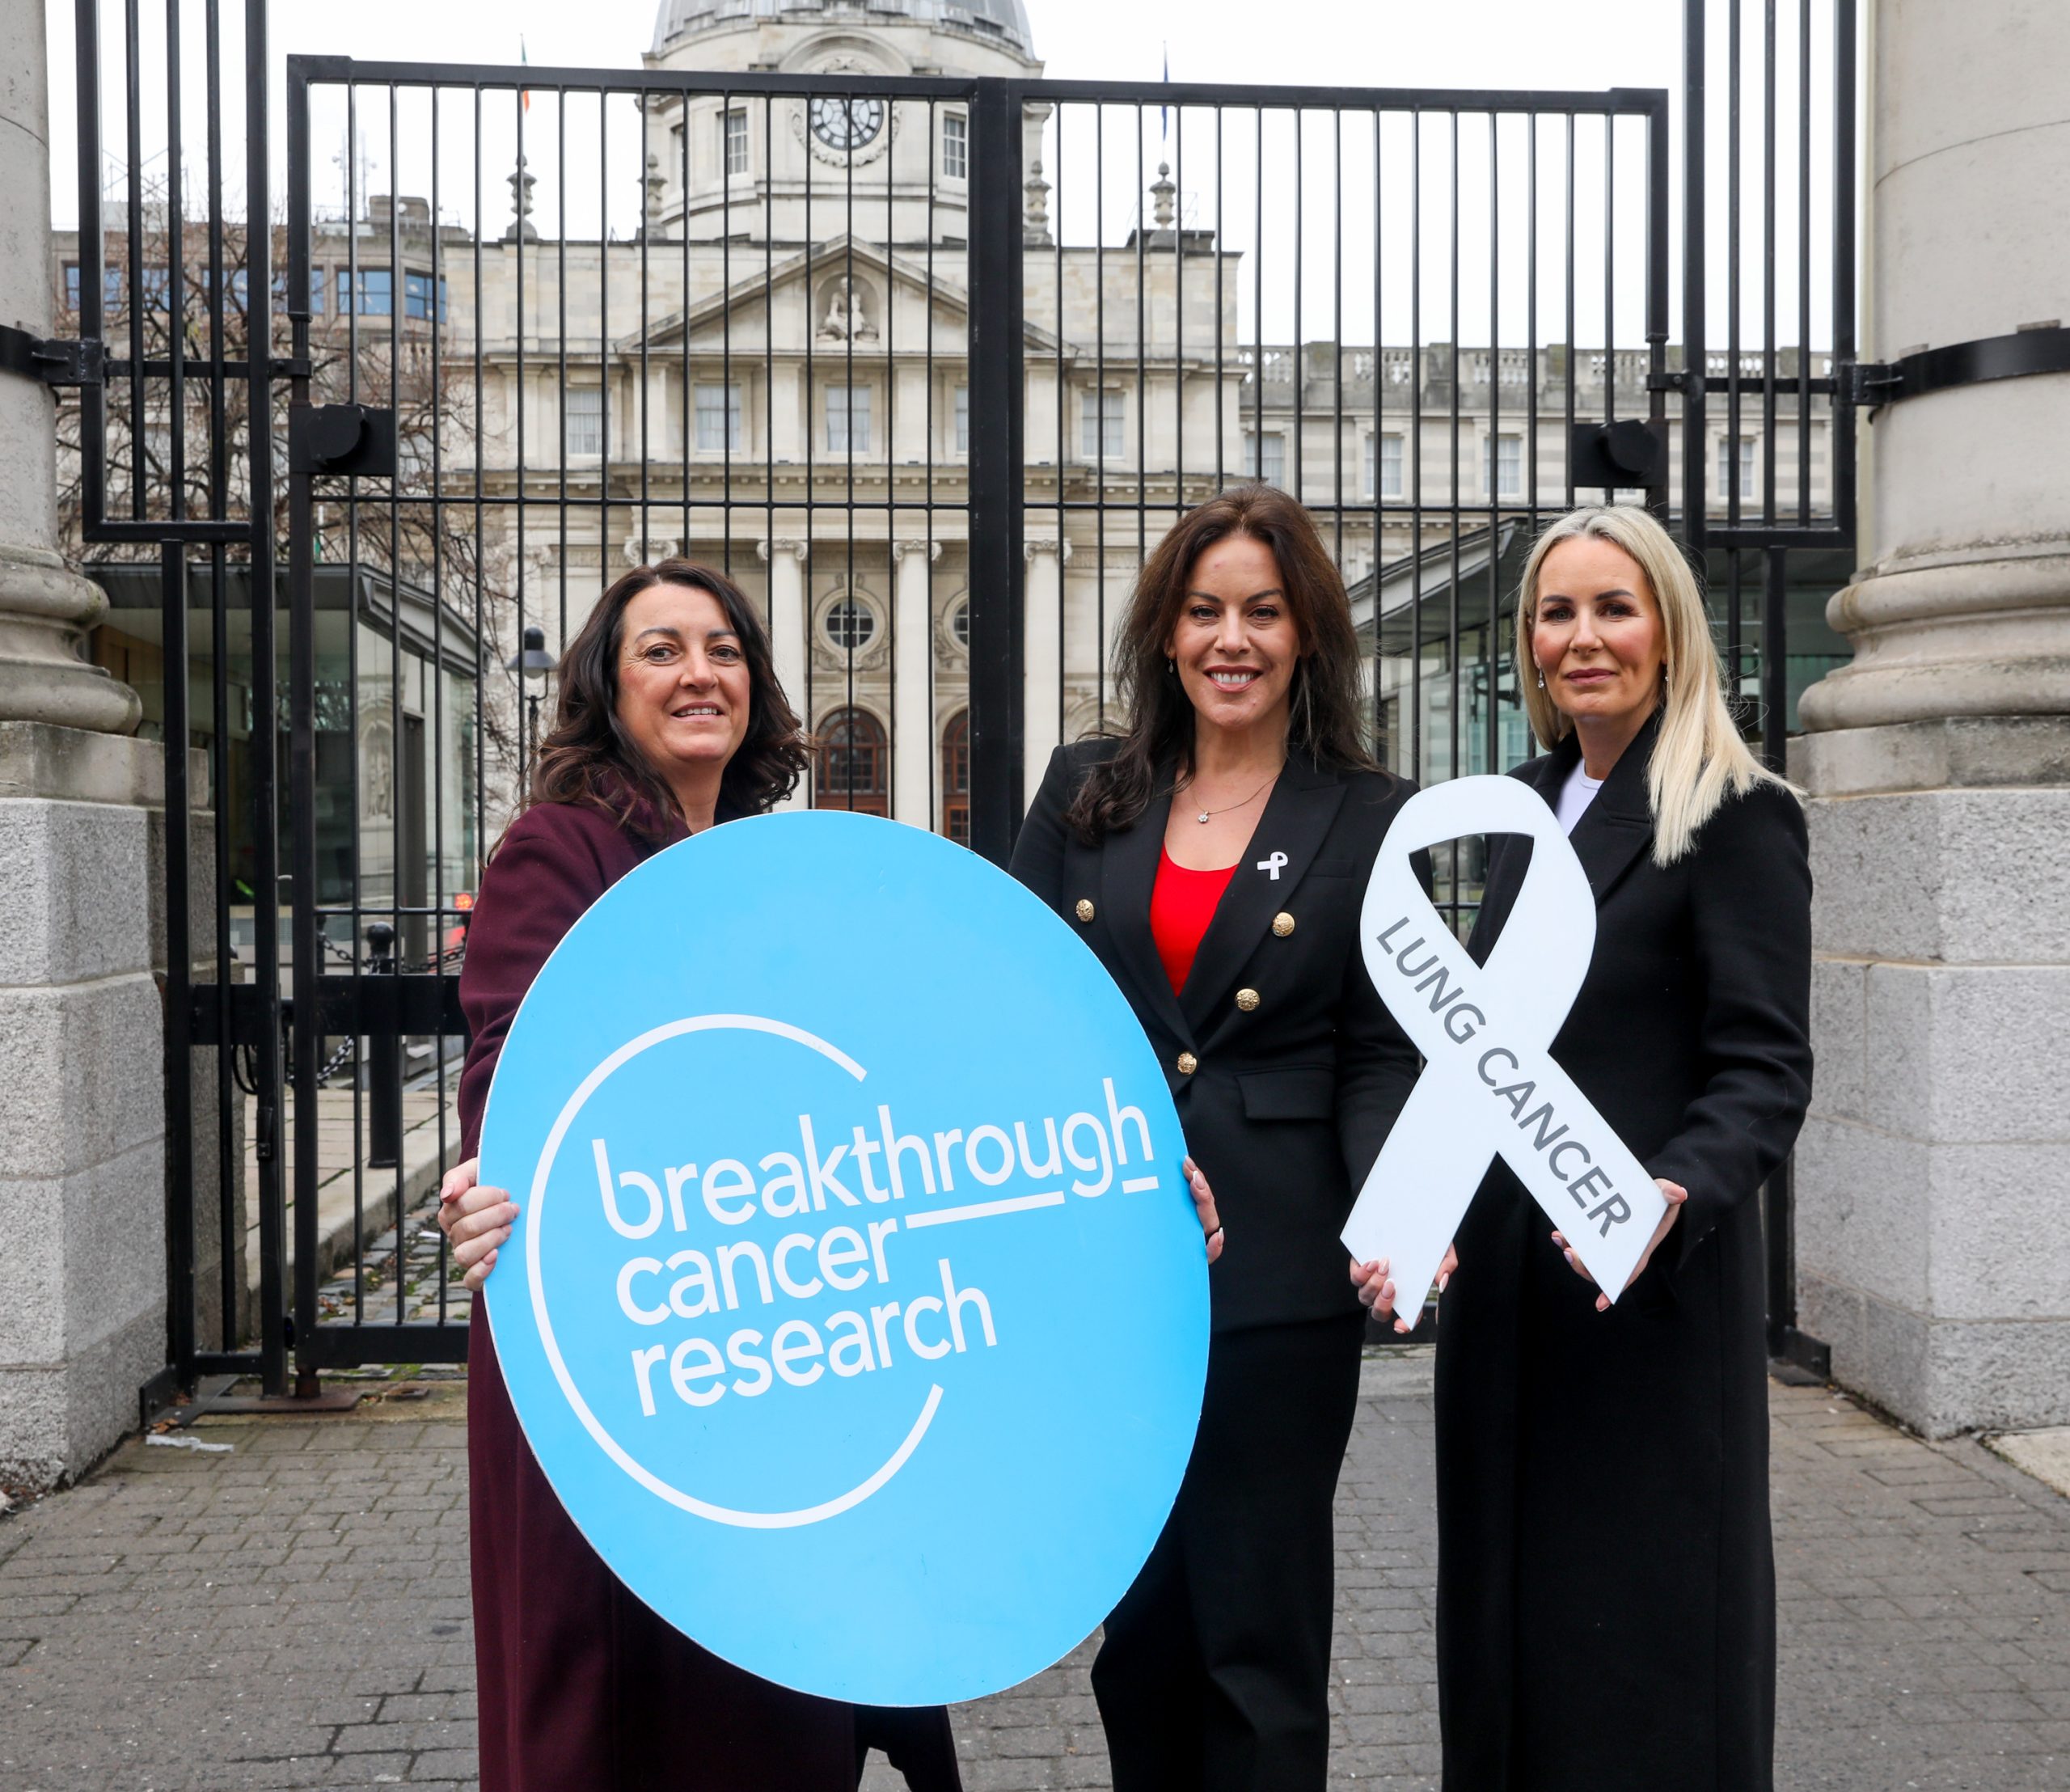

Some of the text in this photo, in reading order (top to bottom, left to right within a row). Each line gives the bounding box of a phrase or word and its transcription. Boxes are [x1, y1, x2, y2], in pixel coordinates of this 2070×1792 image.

[1376, 916, 1631, 1238] LUNG CANCER
[592, 1077, 1154, 1239] breakthrough
[616, 1219, 898, 1325] cancer
[631, 1258, 997, 1416] research
